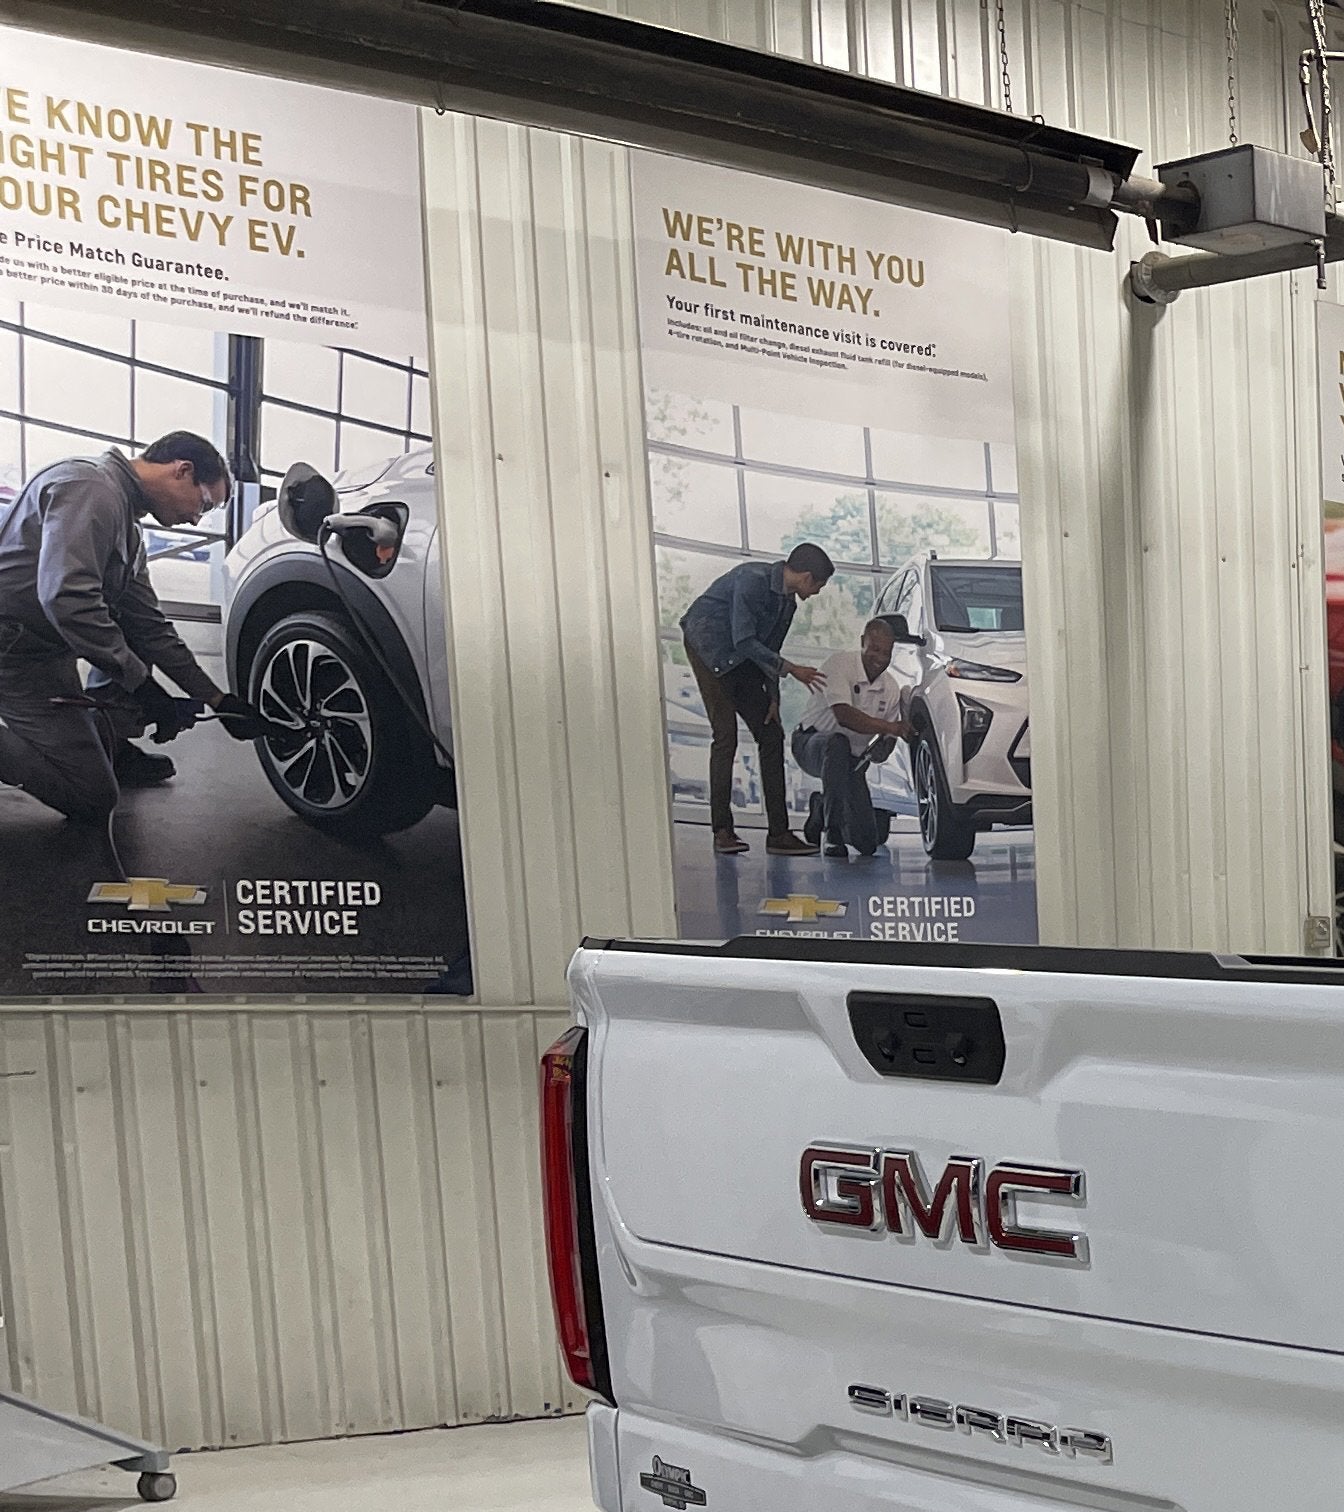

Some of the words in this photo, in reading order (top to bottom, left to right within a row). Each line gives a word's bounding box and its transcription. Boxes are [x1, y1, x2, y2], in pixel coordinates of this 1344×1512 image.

[6, 87, 31, 125] E
[46, 96, 172, 150] KNOW
[186, 122, 263, 167] THE
[0, 130, 94, 179] IGHT
[106, 152, 224, 202] TIRES
[239, 175, 312, 217] FOR
[0, 176, 82, 223] OUR
[97, 194, 234, 246] CHEVY
[248, 219, 305, 258] EV.
[14, 231, 64, 254] Price
[69, 242, 126, 266] Match
[131, 252, 229, 281] Guarantee.
[661, 207, 765, 258] WE'RE
[775, 231, 856, 276] WITH
[866, 249, 926, 288] YOU
[6, 269, 37, 281] better
[40, 275, 65, 287] price
[68, 279, 98, 292] within
[101, 285, 113, 294] 30
[116, 287, 137, 299] days
[140, 292, 150, 300] of
[152, 293, 168, 303] the
[170, 297, 216, 312] purchase,
[218, 303, 234, 313] and
[260, 308, 290, 320] refund
[292, 313, 307, 323] the
[13, 258, 24, 267] us
[27, 260, 49, 271] with
[60, 266, 91, 278] better
[94, 272, 128, 284] eligible
[131, 279, 155, 290] price
[158, 283, 168, 291] at
[170, 284, 185, 293] the
[188, 286, 209, 297] time
[223, 292, 268, 307] purchase,
[270, 299, 286, 308] and
[310, 304, 338, 315] match
[664, 248, 727, 288] ALL
[735, 262, 798, 302] THE
[807, 277, 881, 317] WAY.
[666, 294, 700, 314] Your
[703, 302, 736, 322] first
[740, 313, 829, 340] maintenance
[832, 329, 862, 345] visit
[865, 334, 877, 347] is
[236, 879, 381, 907] CERTIFIED
[868, 895, 976, 918] CERTIFIED
[87, 918, 215, 935] CHEVROLET
[238, 909, 359, 936] SERVICE
[870, 922, 959, 943] SERVICE
[800, 1141, 1088, 1264] GMC
[847, 1383, 1114, 1464] SIERRA
